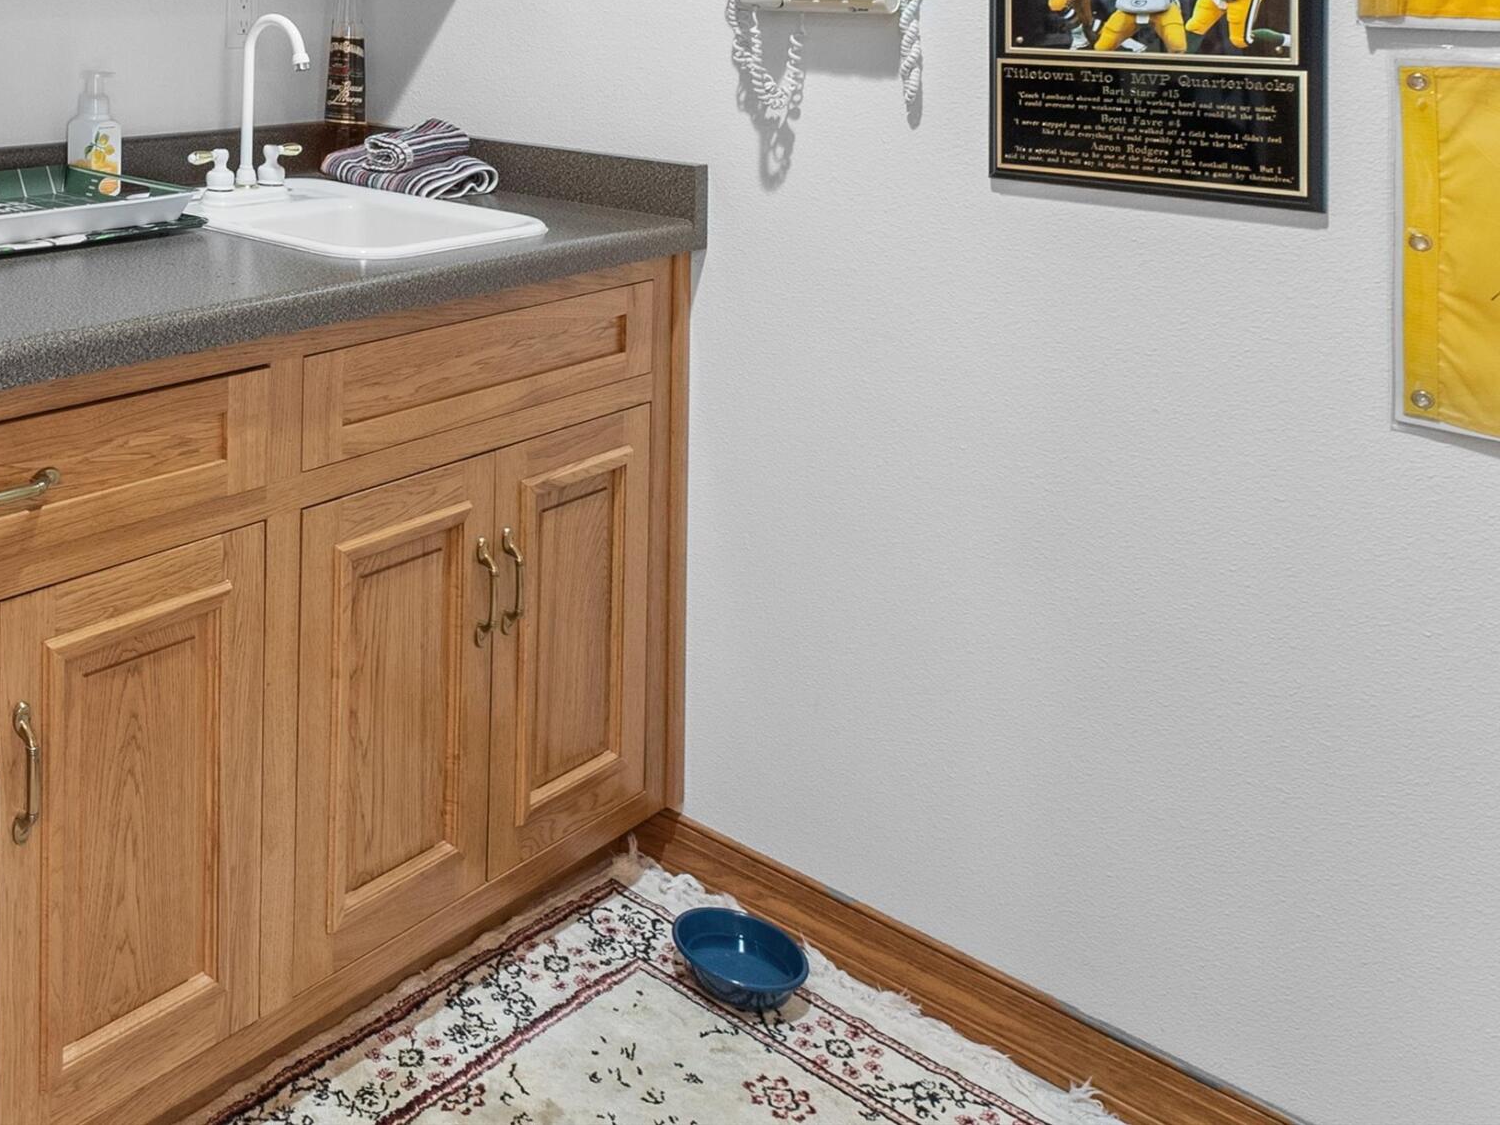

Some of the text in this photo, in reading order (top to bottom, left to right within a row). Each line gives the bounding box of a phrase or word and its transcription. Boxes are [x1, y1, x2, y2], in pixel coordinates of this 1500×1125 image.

[1004, 66, 1295, 93] Titletown Trio MVP Quarterbacks
[1102, 85, 1124, 96] Bart
[1101, 113, 1127, 125] Brett
[1133, 116, 1163, 127] Favre
[1090, 142, 1121, 153] Aaron
[1126, 143, 1169, 158] Rodgers
